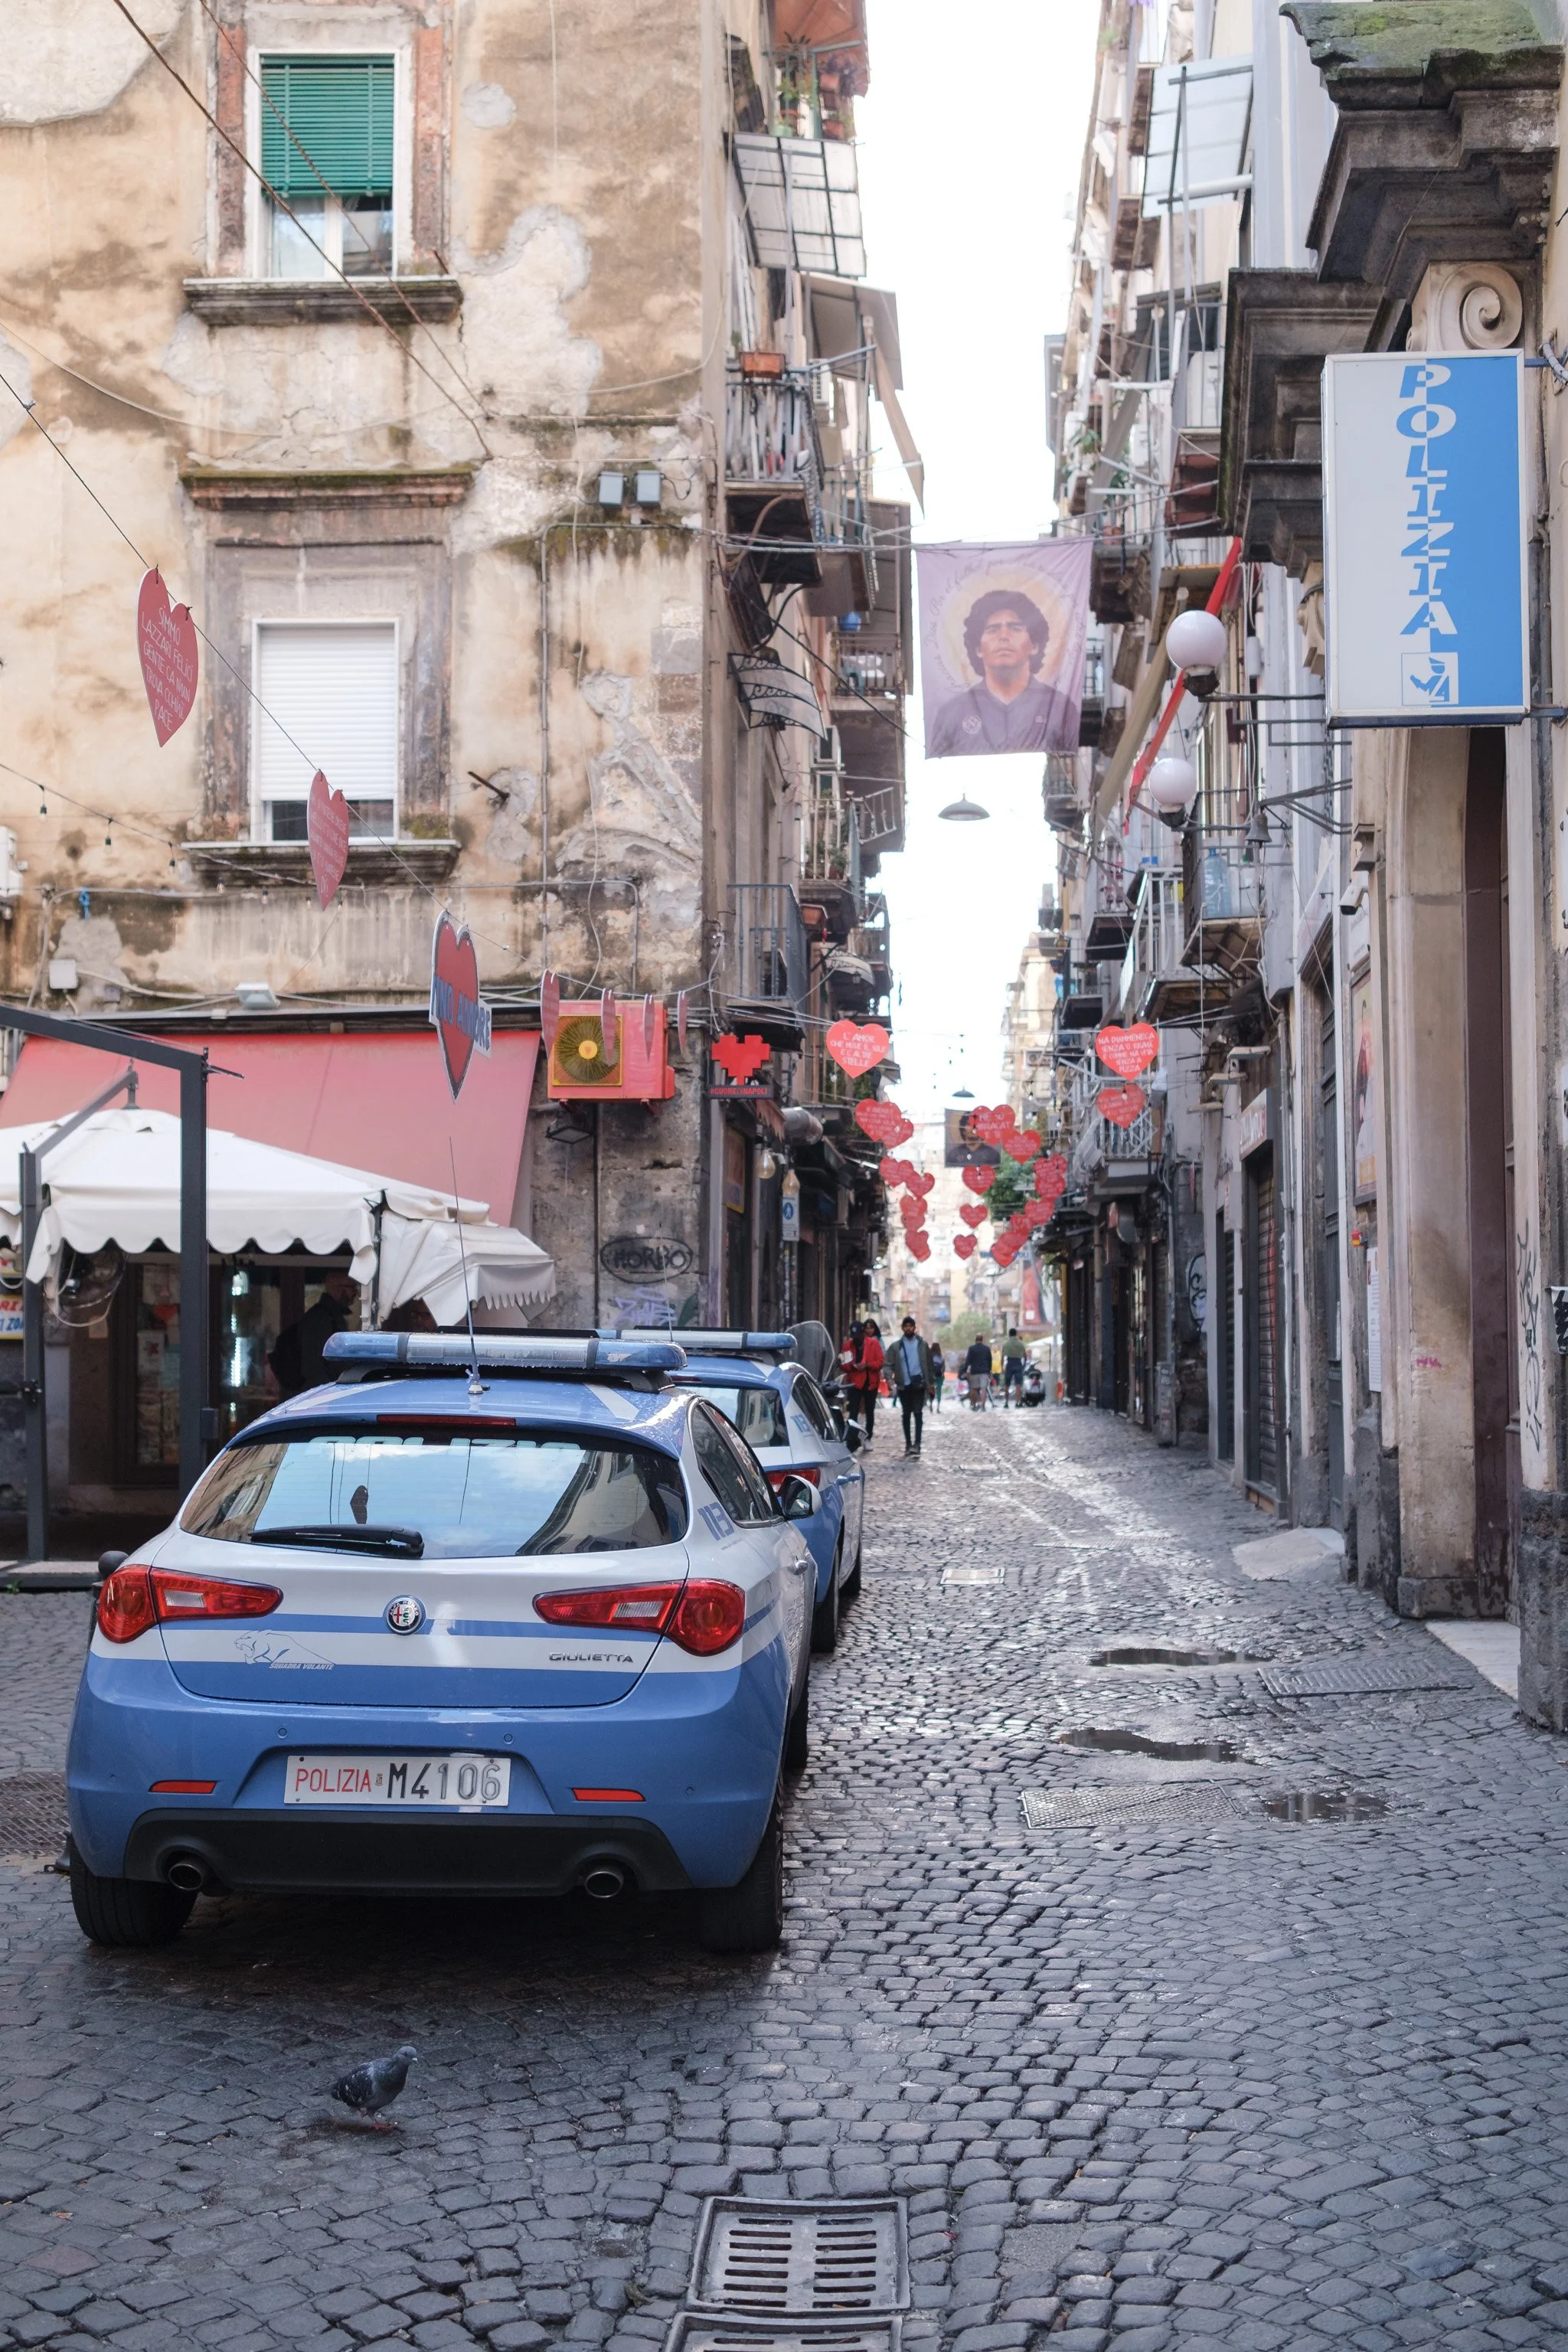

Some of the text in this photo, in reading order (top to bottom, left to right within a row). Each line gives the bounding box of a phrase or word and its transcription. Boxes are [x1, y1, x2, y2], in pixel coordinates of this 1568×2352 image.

[1396, 364, 1458, 635] POLIZIA
[142, 611, 192, 683] LAZZARI FELICI
[143, 640, 165, 675] GENTE
[154, 697, 174, 732] PACE
[697, 1501, 735, 1541] 113
[302, 1662, 335, 1671] VOLANTE
[549, 1653, 634, 1664] GIULIETTA
[296, 1762, 501, 1801] POLIZIA M4106
